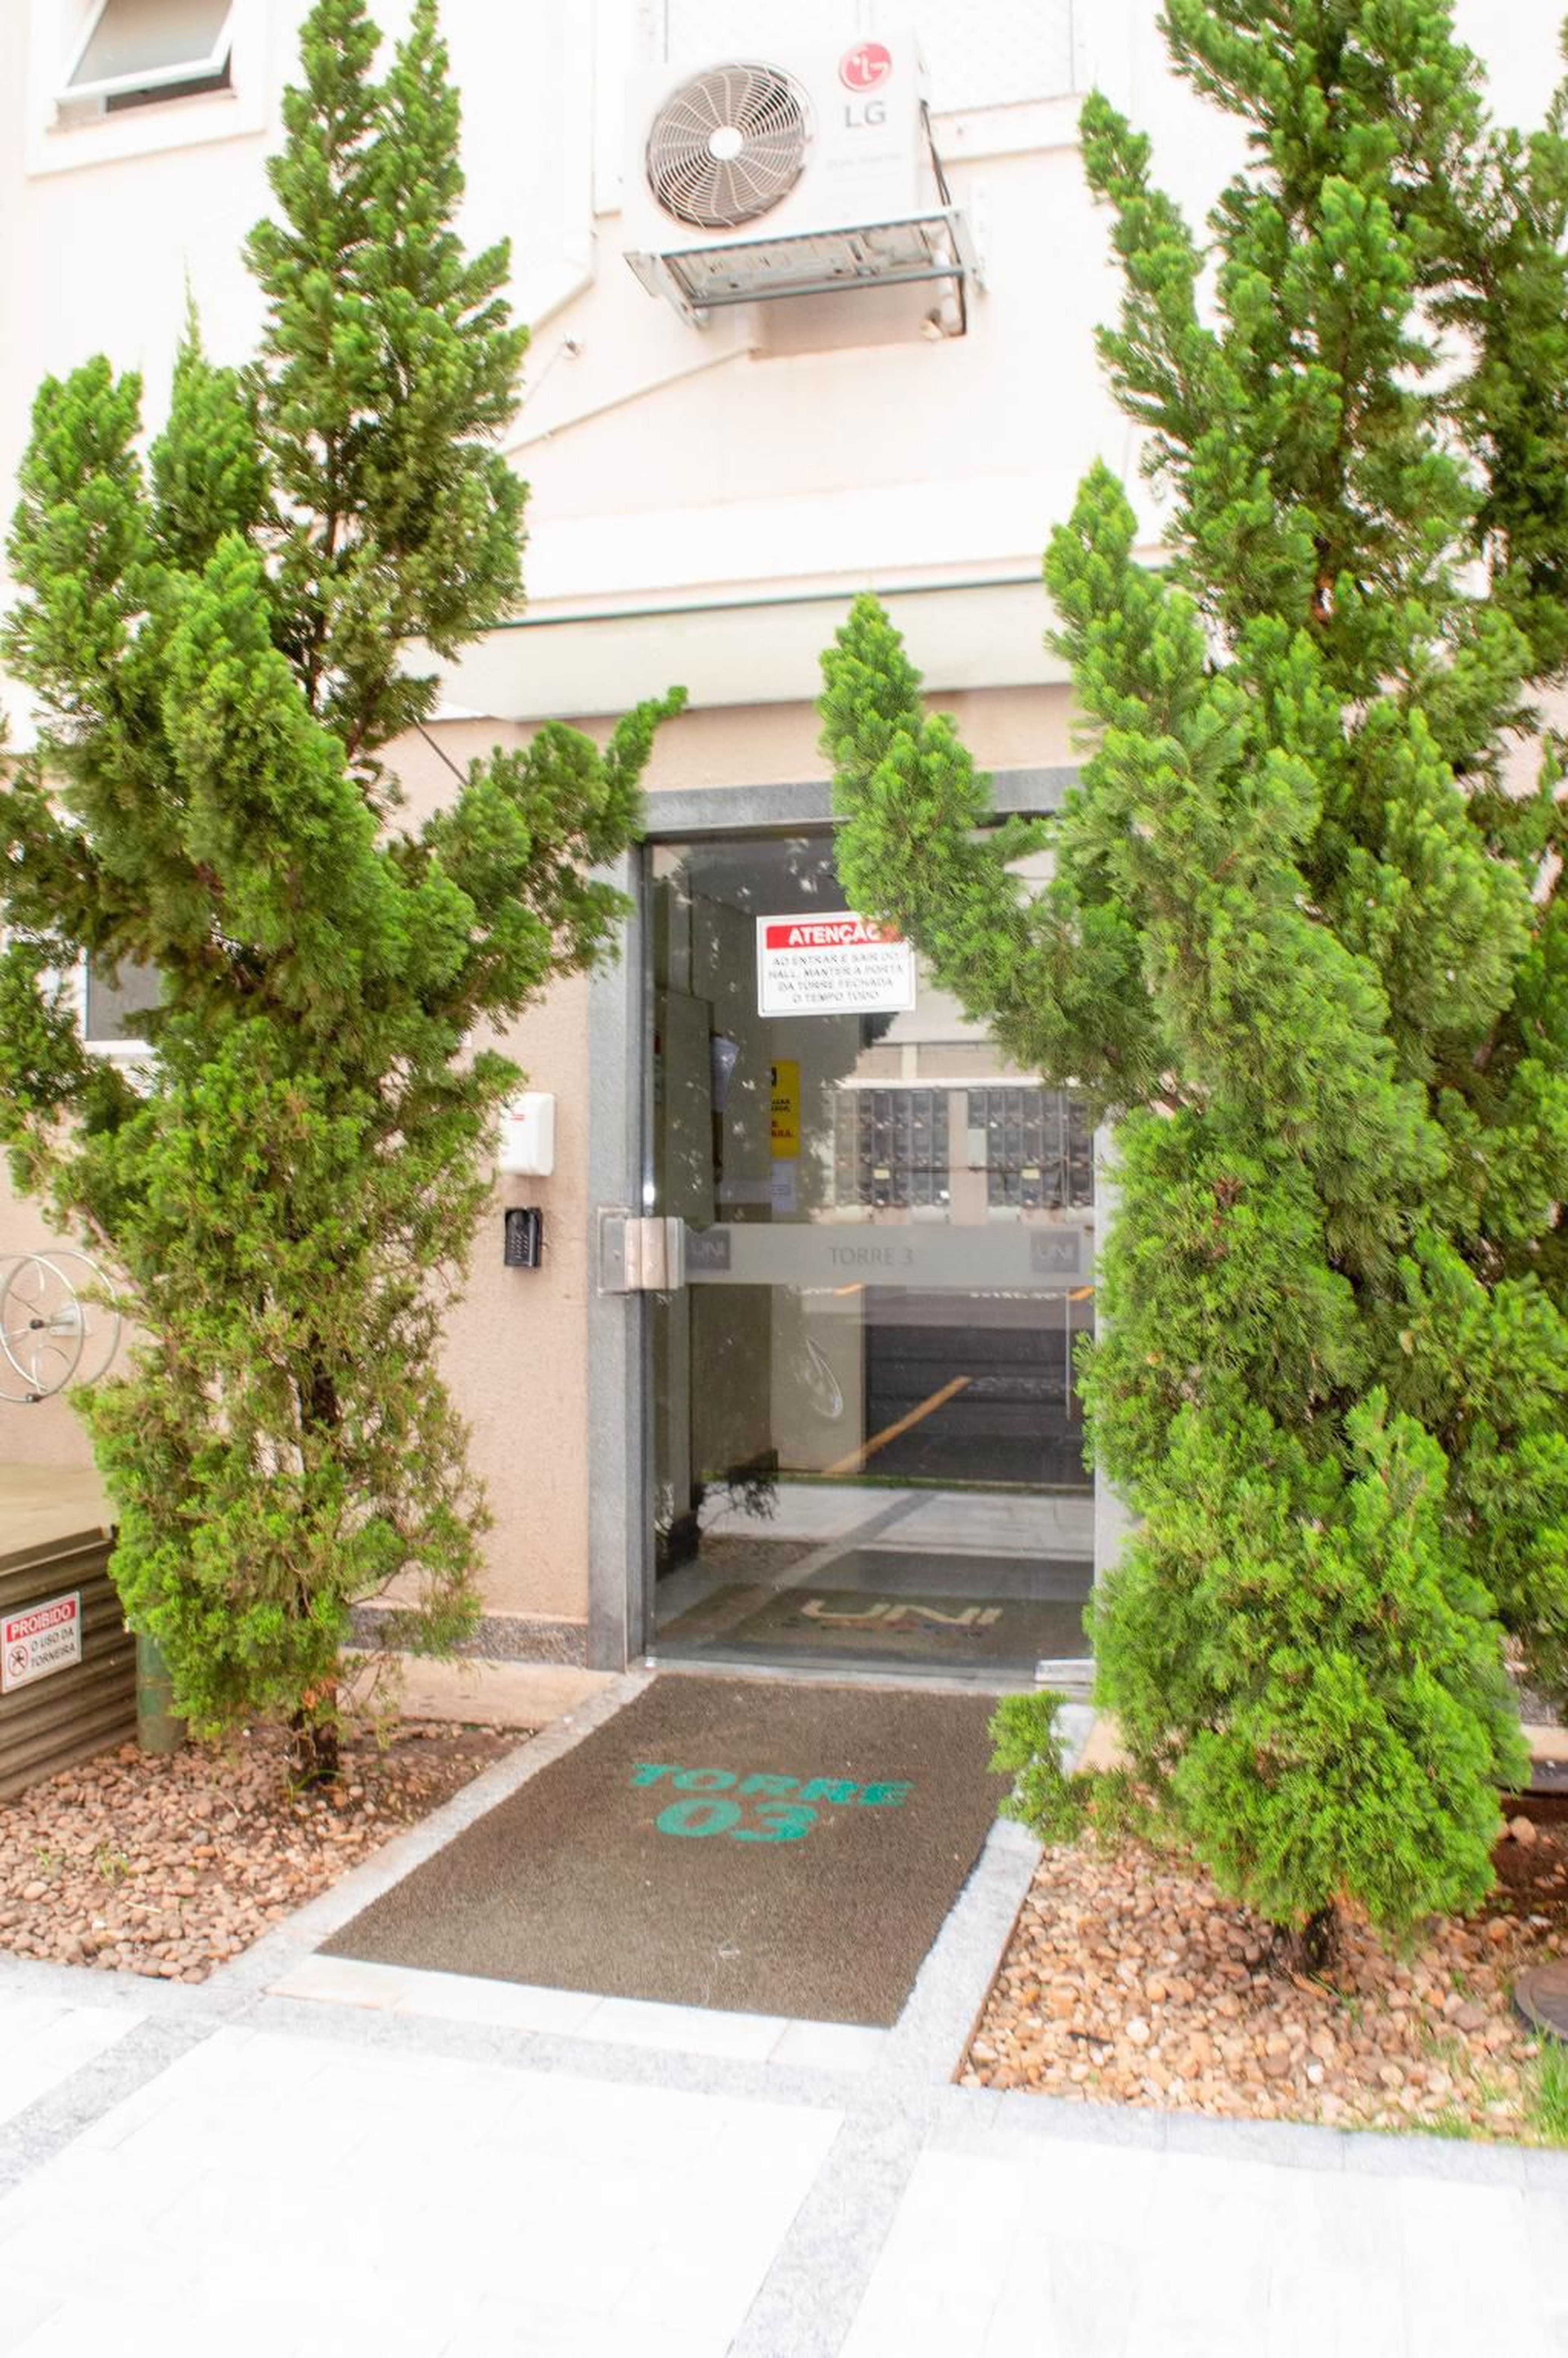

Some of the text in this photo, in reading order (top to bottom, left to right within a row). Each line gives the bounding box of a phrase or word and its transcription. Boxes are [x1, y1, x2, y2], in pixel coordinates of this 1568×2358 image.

[844, 100, 886, 127] LG
[773, 956, 789, 965] AO
[855, 966, 861, 975] A
[778, 982, 794, 991] DA
[827, 1247, 913, 1266] TORRE 3
[11, 1604, 71, 1639] PROIBIDO
[41, 1632, 58, 1647] USO
[31, 1642, 75, 1668] TORNEIRA
[630, 1763, 918, 1806] TORRE
[657, 1798, 817, 1841] 03
